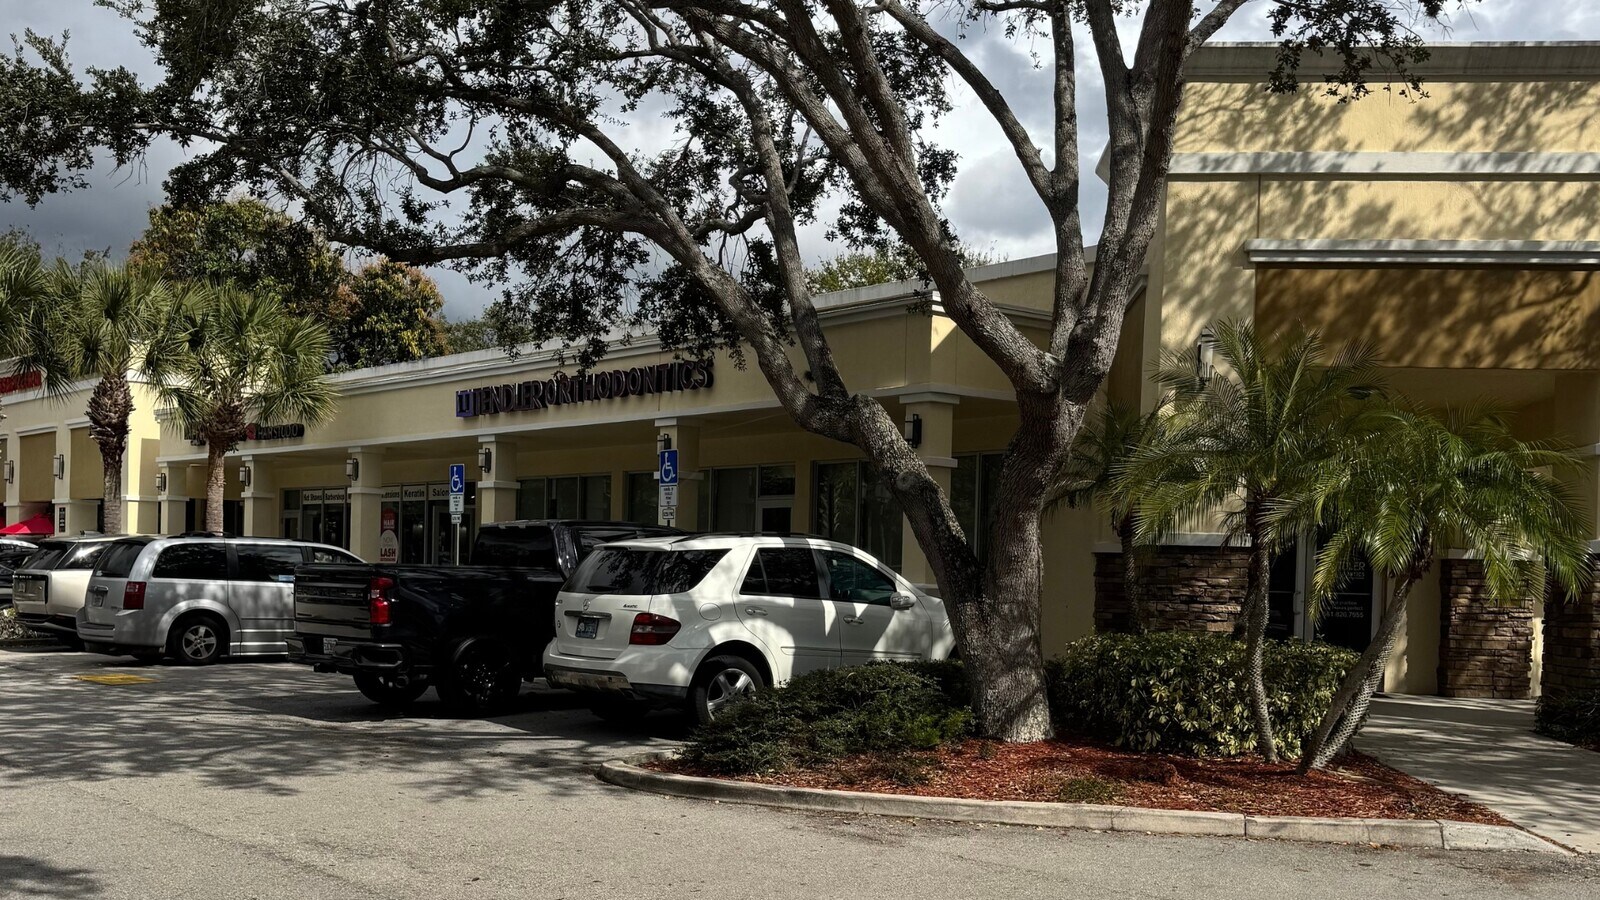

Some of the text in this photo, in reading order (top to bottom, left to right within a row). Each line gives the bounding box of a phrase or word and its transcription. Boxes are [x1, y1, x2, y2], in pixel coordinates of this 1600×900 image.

[472, 380, 547, 416] TENDLER
[545, 359, 712, 405] ORTHODONTICS
[404, 489, 425, 498] Keratin
[380, 547, 396, 557] LASH
